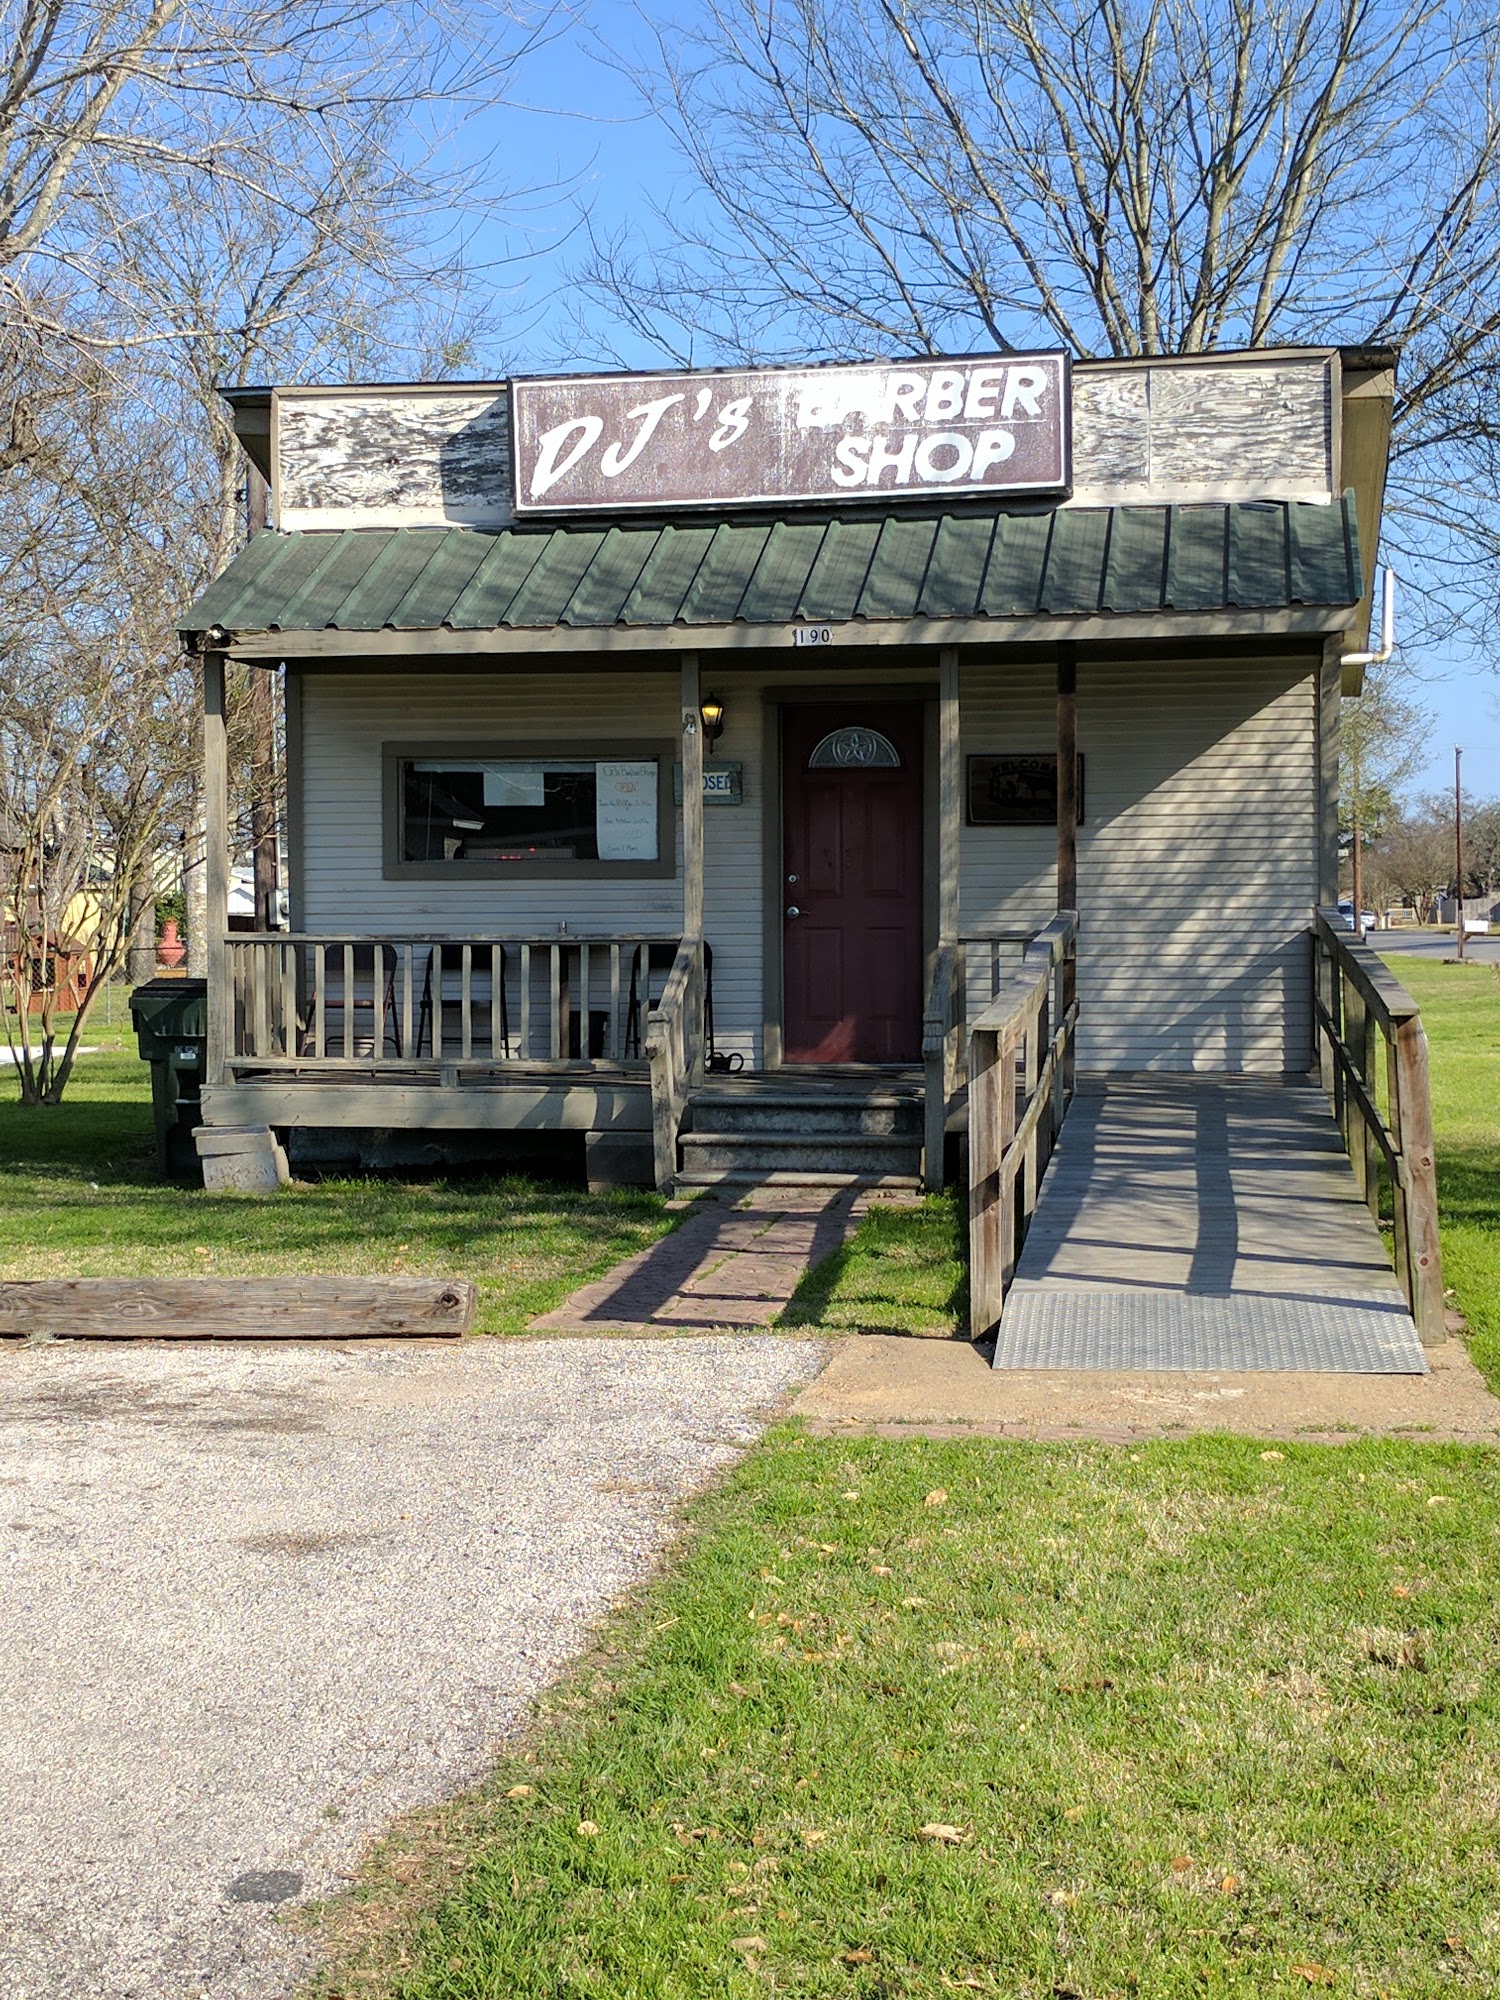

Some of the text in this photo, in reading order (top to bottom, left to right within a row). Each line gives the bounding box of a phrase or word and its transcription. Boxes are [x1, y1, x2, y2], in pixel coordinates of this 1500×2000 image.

[529, 387, 754, 500] DJ's
[830, 428, 1016, 488] SHOP
[800, 628, 830, 644] 190
[703, 775, 730, 790] OSE
